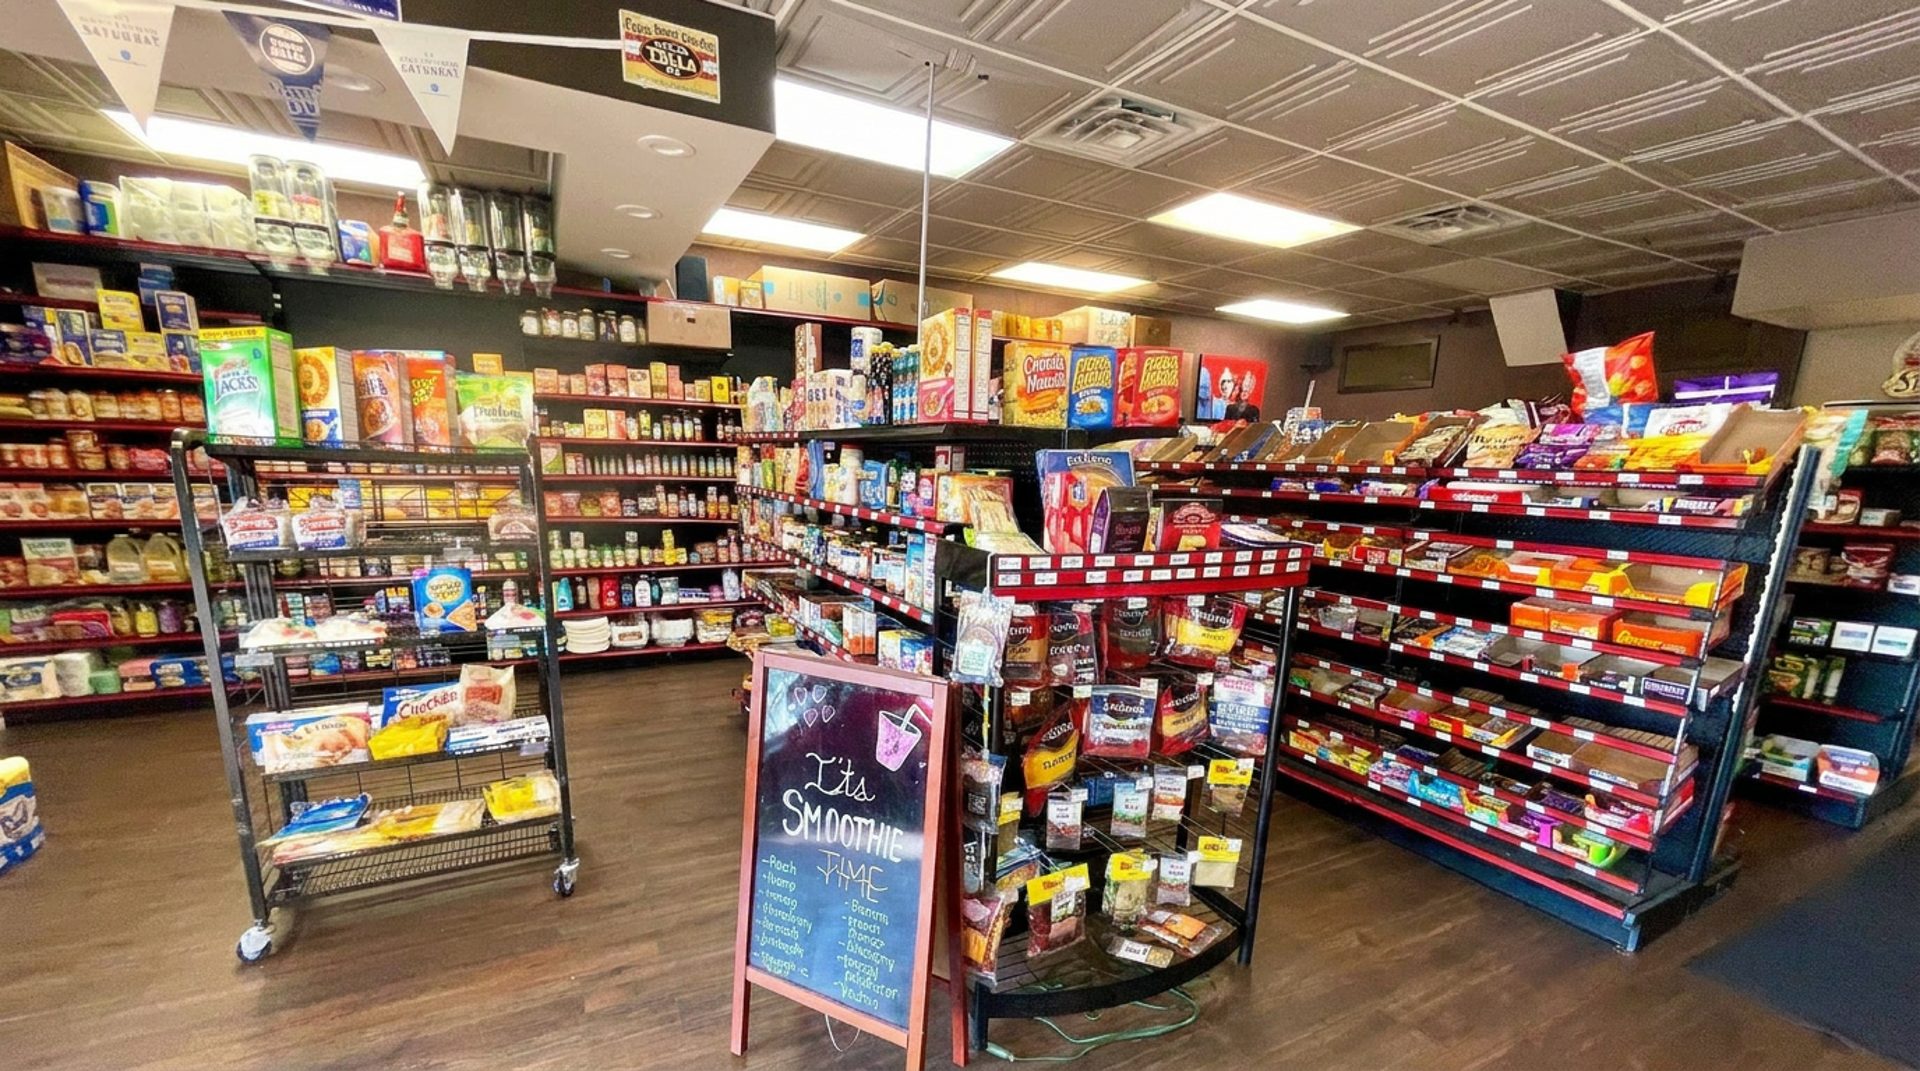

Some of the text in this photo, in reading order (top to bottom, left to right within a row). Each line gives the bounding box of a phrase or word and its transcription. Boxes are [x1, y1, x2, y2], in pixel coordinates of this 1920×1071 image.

[805, 753, 876, 802] It's
[782, 788, 904, 863] SMOOTHIE
[816, 848, 889, 903] TIME
